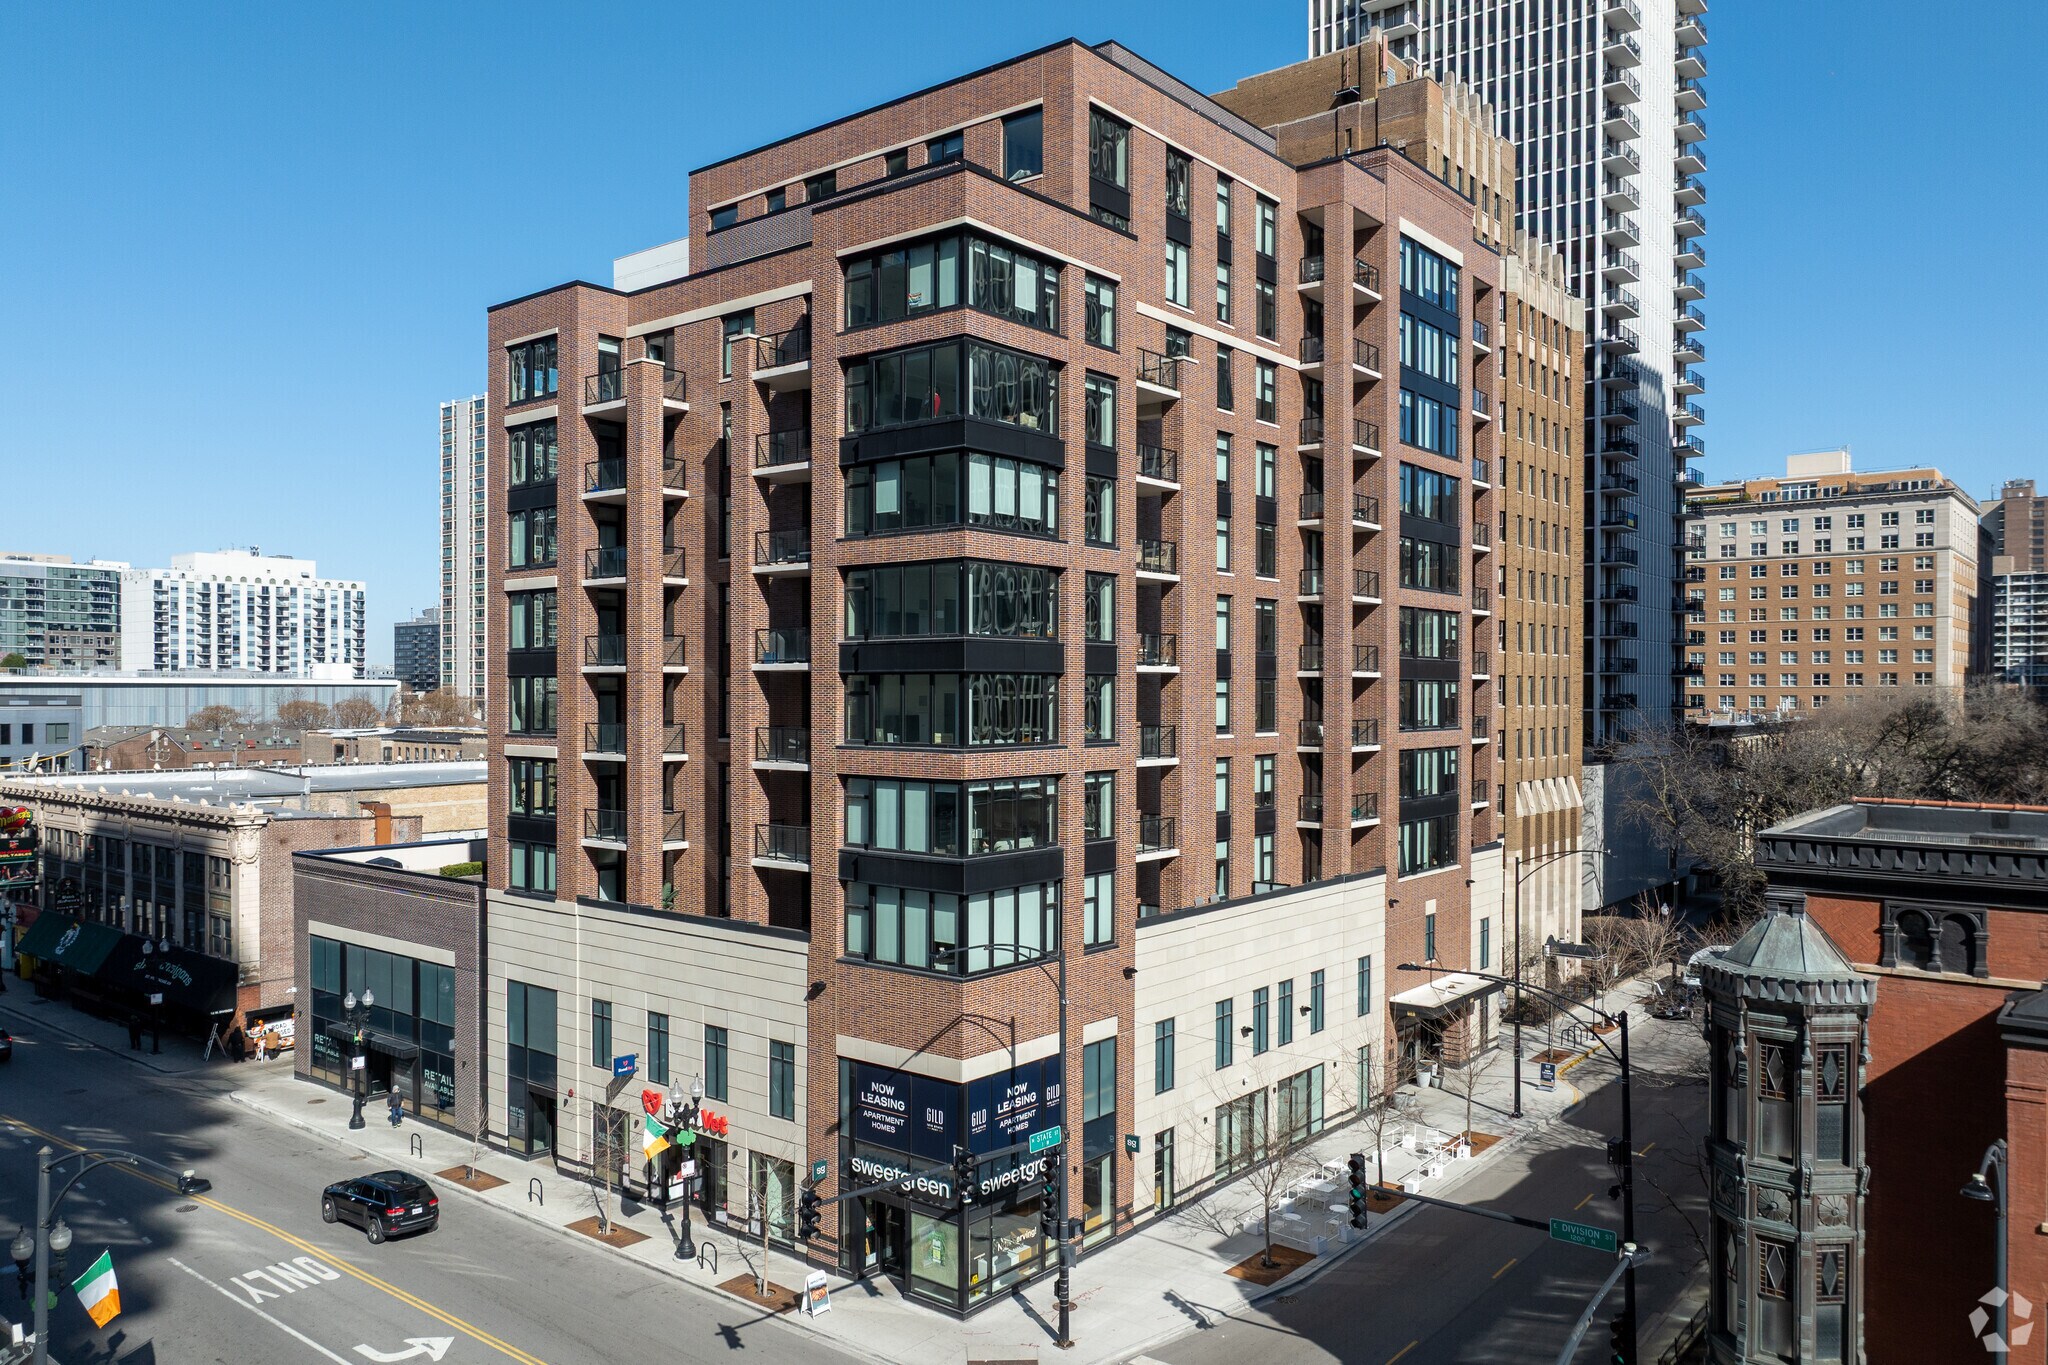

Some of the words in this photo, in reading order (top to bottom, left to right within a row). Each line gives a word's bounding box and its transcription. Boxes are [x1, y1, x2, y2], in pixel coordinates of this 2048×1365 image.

[871, 1081, 895, 1096] NOW
[1007, 1081, 1028, 1098] NOW
[1046, 1083, 1060, 1101] GILD
[861, 1091, 906, 1112] LEASING
[997, 1091, 1037, 1114] LEASING
[863, 1110, 905, 1126] APARTMENT
[926, 1107, 944, 1125] GILD
[971, 1108, 987, 1127] GILD
[999, 1109, 1037, 1129] APARTMENT
[871, 1121, 896, 1134] HOMES
[1007, 1121, 1029, 1135] HOMES
[1036, 1131, 1052, 1142] STATE
[816, 1165, 826, 1175] sg
[981, 1155, 1060, 1196] sweetgre
[1562, 1223, 1600, 1239] DIVISION
[1570, 1234, 1586, 1243] 1200
[229, 1256, 341, 1304] ONLY
